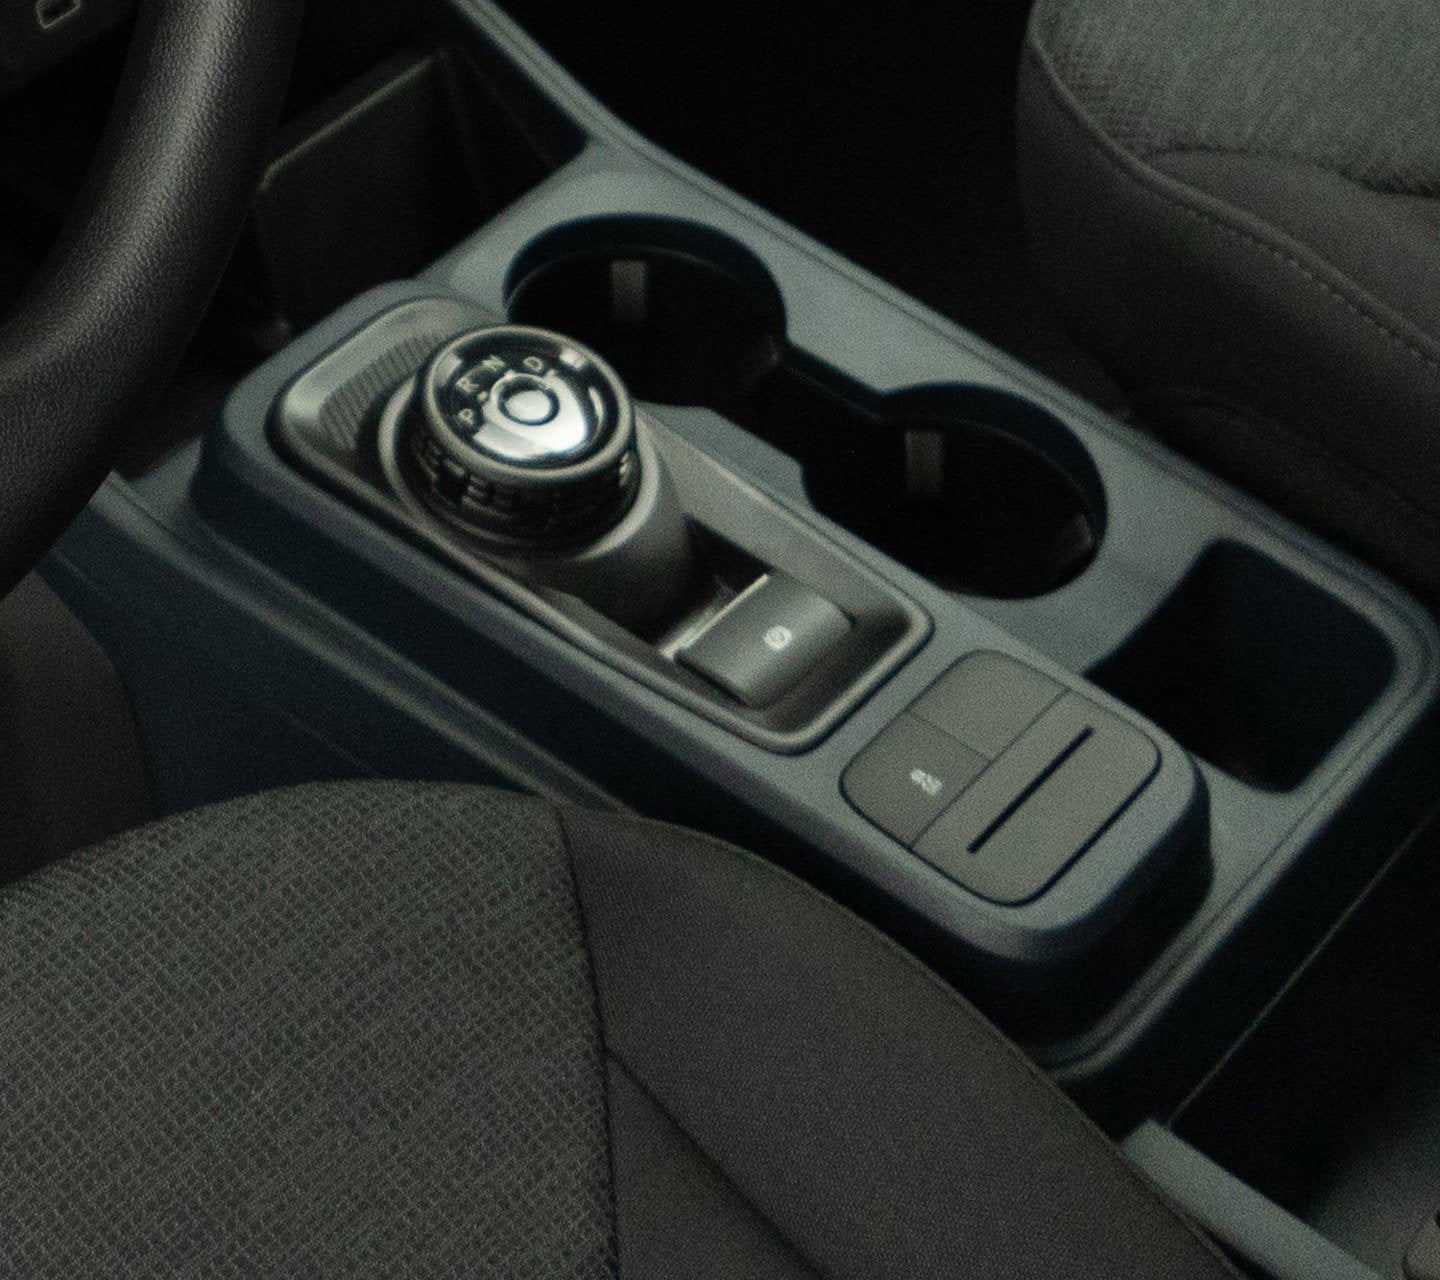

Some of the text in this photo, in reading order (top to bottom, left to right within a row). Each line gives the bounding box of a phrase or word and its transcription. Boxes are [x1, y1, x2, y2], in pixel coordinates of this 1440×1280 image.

[456, 354, 545, 426] P R N D
